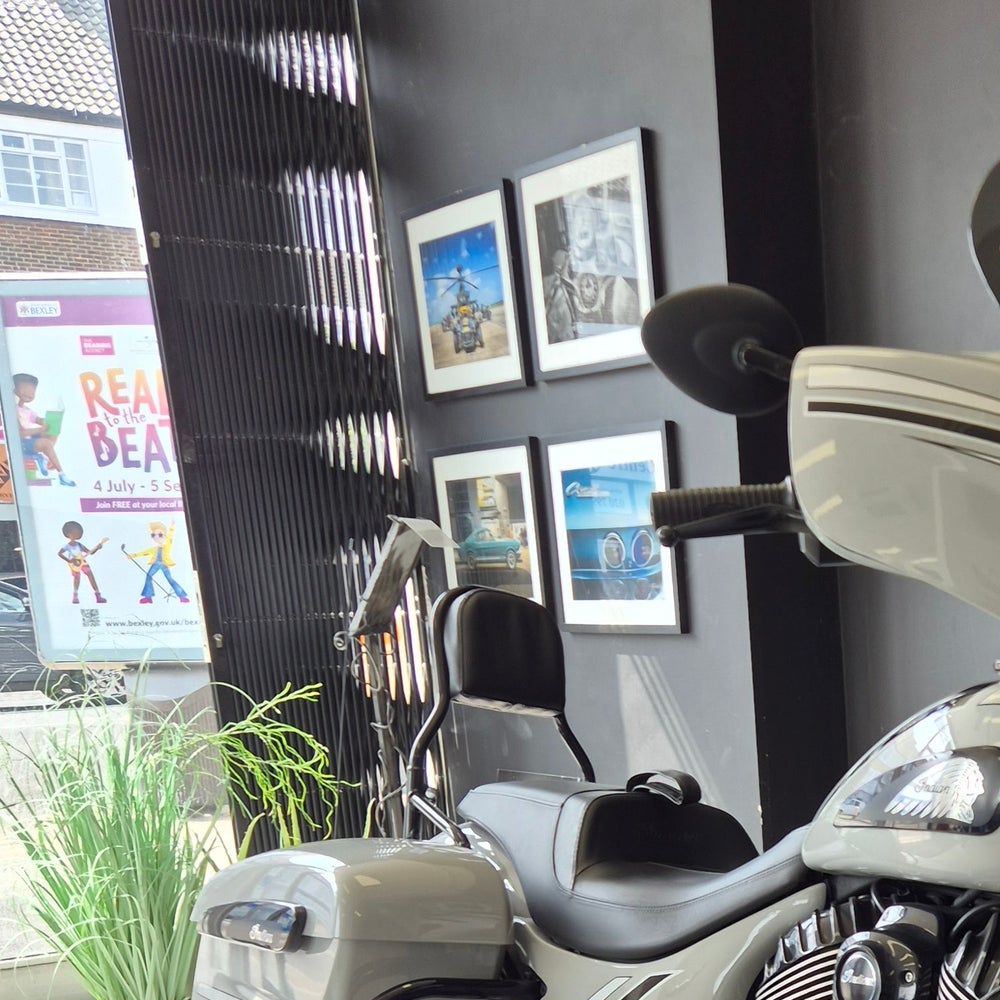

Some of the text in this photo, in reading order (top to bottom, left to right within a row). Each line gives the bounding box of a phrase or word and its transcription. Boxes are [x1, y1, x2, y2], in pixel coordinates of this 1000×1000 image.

[30, 306, 57, 315] BEXLEY
[104, 407, 147, 427] to the
[93, 479, 102, 492] 4
[107, 479, 135, 494] July
[151, 479, 159, 492] 5
[96, 501, 111, 509] Join
[159, 500, 177, 508] local
